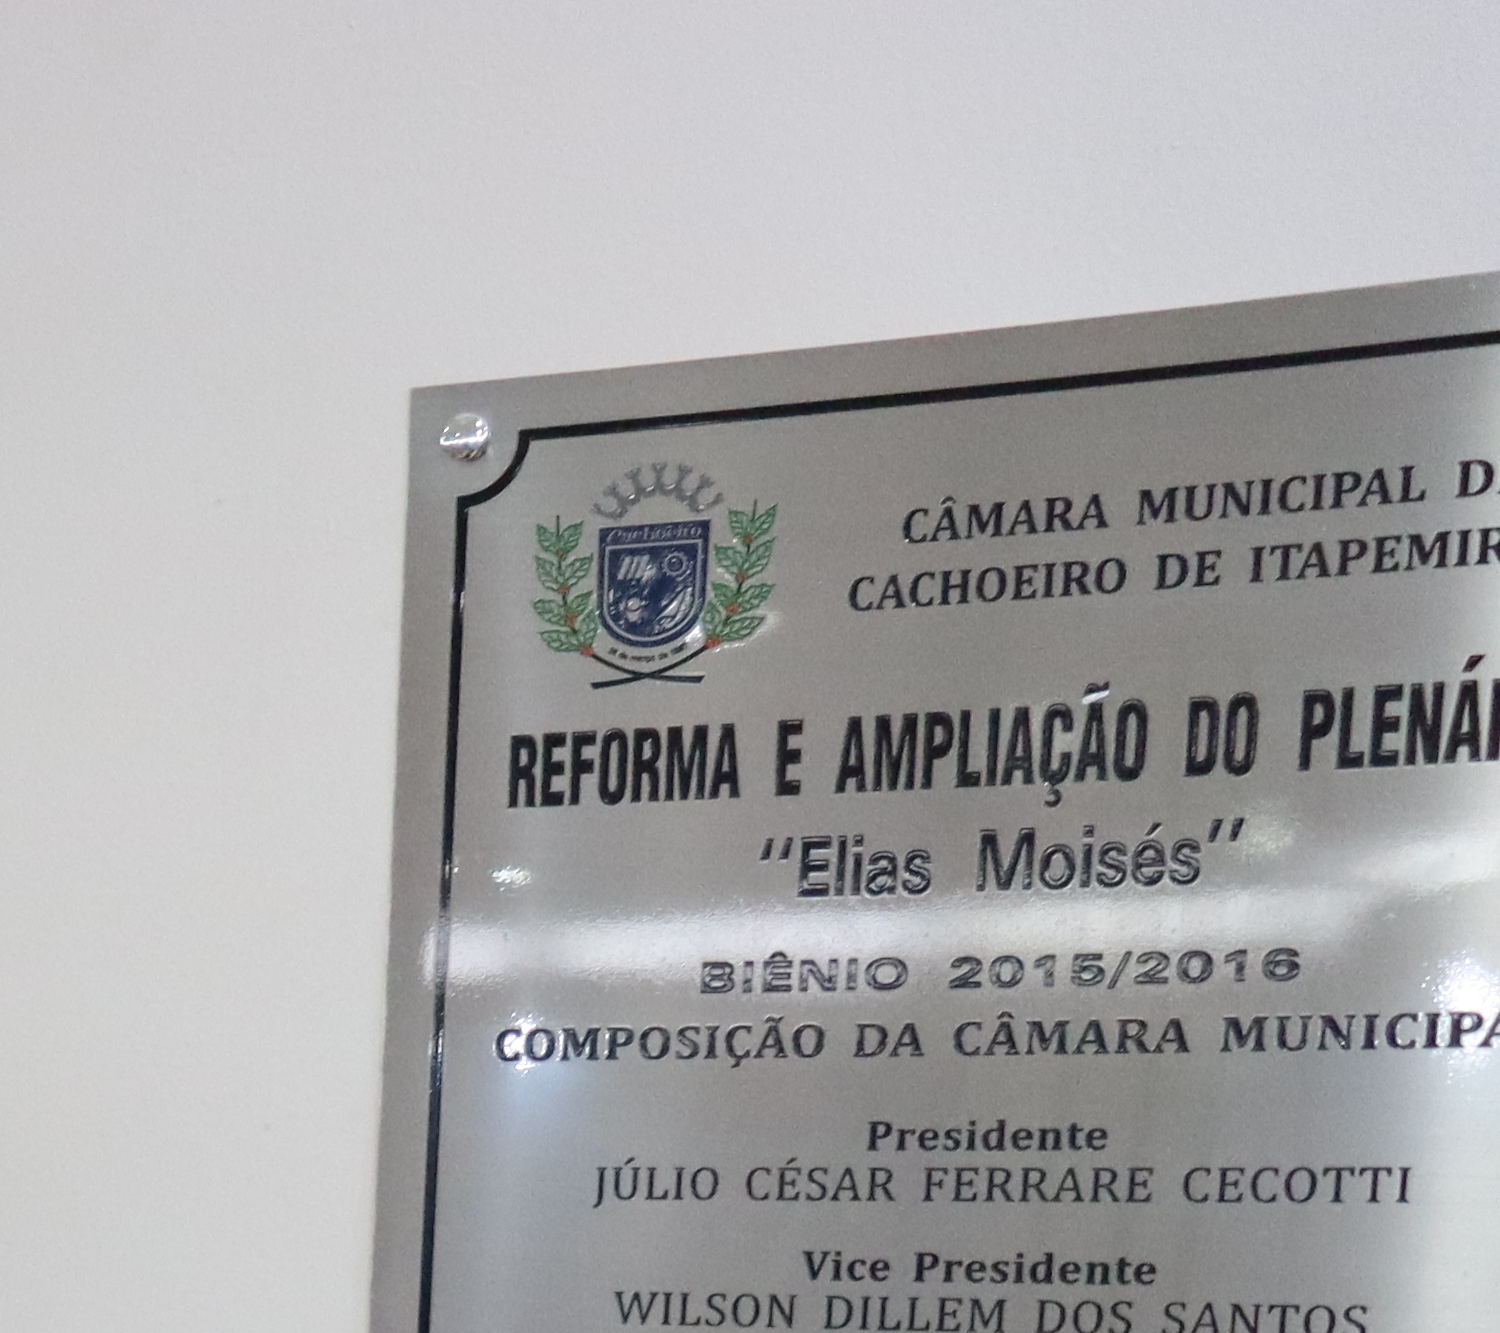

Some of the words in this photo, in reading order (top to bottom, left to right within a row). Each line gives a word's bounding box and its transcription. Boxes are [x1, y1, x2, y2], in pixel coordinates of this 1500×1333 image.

[902, 495, 1109, 544] CÂMARA
[1137, 465, 1426, 527] MUNICIPAL
[1456, 458, 1500, 499] D
[848, 557, 1127, 612] CACHOEIRO
[1155, 550, 1222, 590] DE
[507, 723, 740, 808] REFORMA
[775, 719, 804, 796] E
[834, 681, 1149, 808] AMPLIAÇÃO
[1184, 691, 1258, 779] DO
[700, 951, 909, 994] BIÊNIO
[949, 947, 1301, 990] 2015/2016
[493, 1014, 826, 1068] COMPOSIÇÃO
[853, 1021, 925, 1058] DA
[953, 1010, 1191, 1057] CÂMARA
[866, 1119, 1108, 1152] Presidente
[593, 1157, 720, 1208] JÚLIO
[745, 1157, 897, 1202] CÉSAR
[922, 1166, 1155, 1203] FERRARE
[1182, 1166, 1412, 1204] CECOTTI
[803, 1250, 890, 1282] Vice
[913, 1251, 1157, 1285] Presidente
[614, 1290, 798, 1329] WILSON
